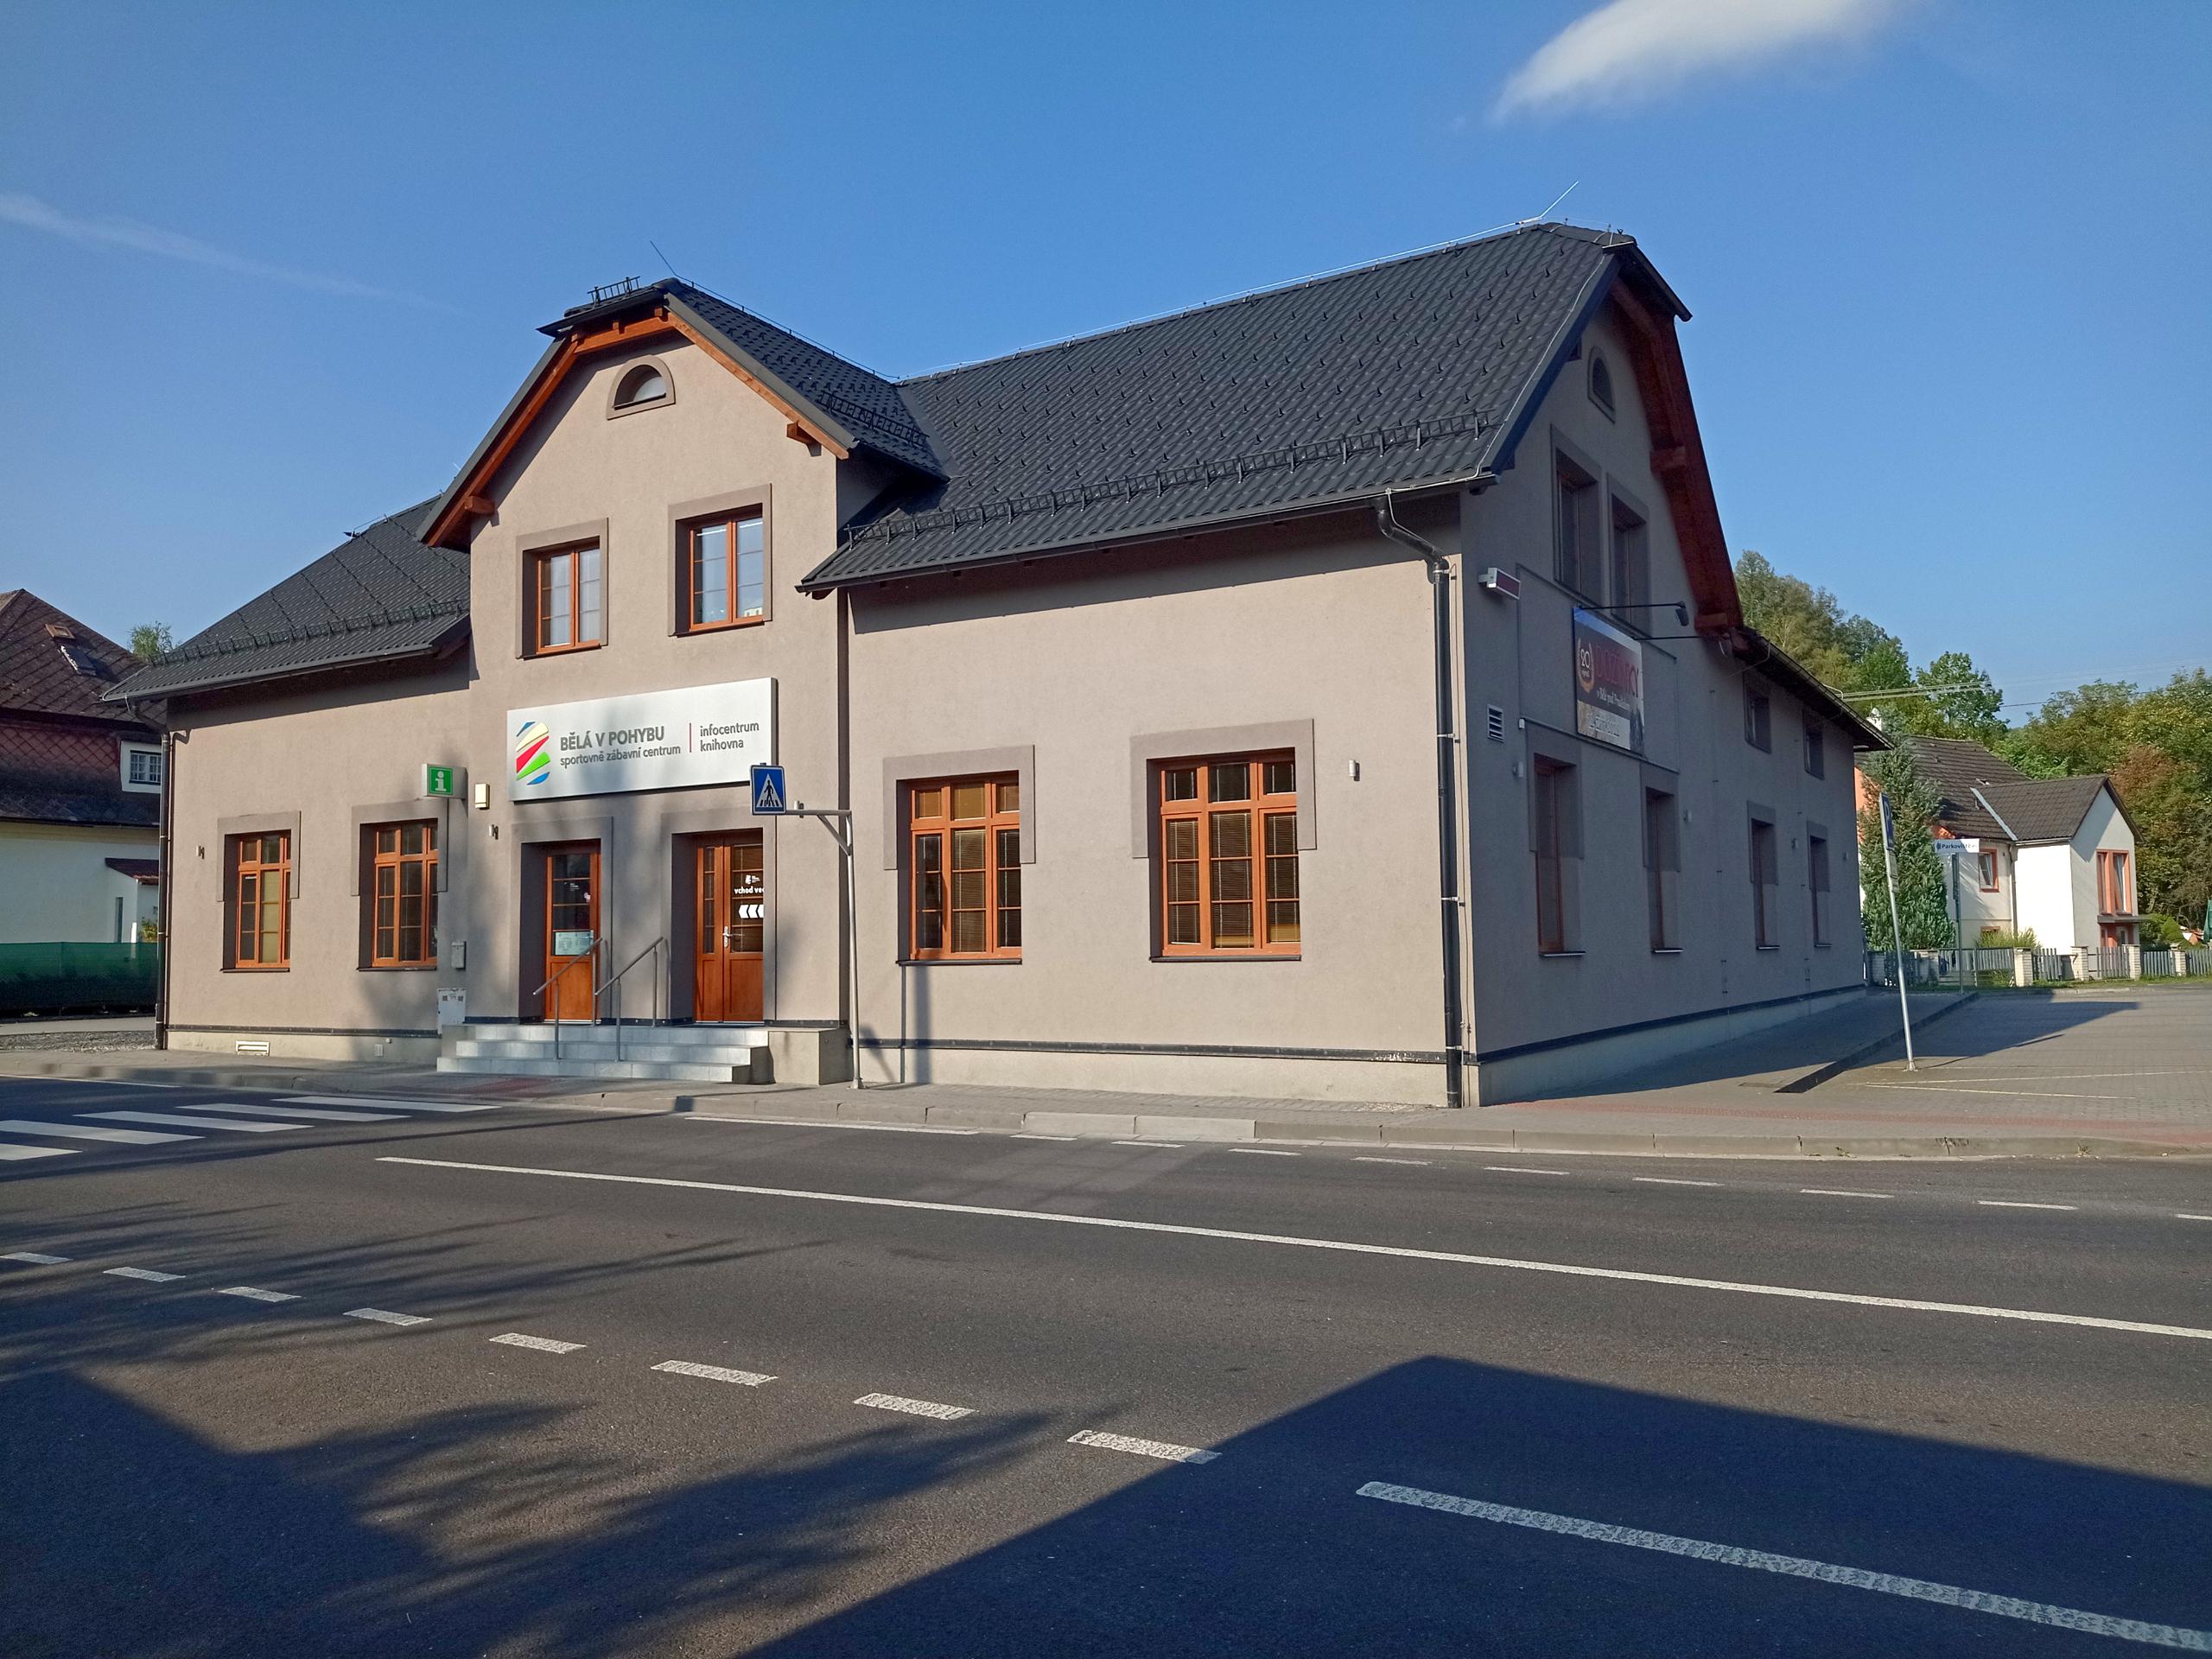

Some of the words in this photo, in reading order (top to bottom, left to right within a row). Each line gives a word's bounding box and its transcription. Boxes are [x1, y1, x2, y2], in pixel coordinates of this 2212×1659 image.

[700, 722, 760, 737] infocentrum
[561, 730, 593, 751] BĚLÁ
[595, 733, 605, 747] V
[608, 726, 664, 746] POHYBU
[700, 738, 744, 752] knihovna
[561, 751, 604, 769] sportovně
[607, 747, 641, 761] zábavní
[643, 746, 681, 758] centrum
[734, 886, 753, 894] vchod
